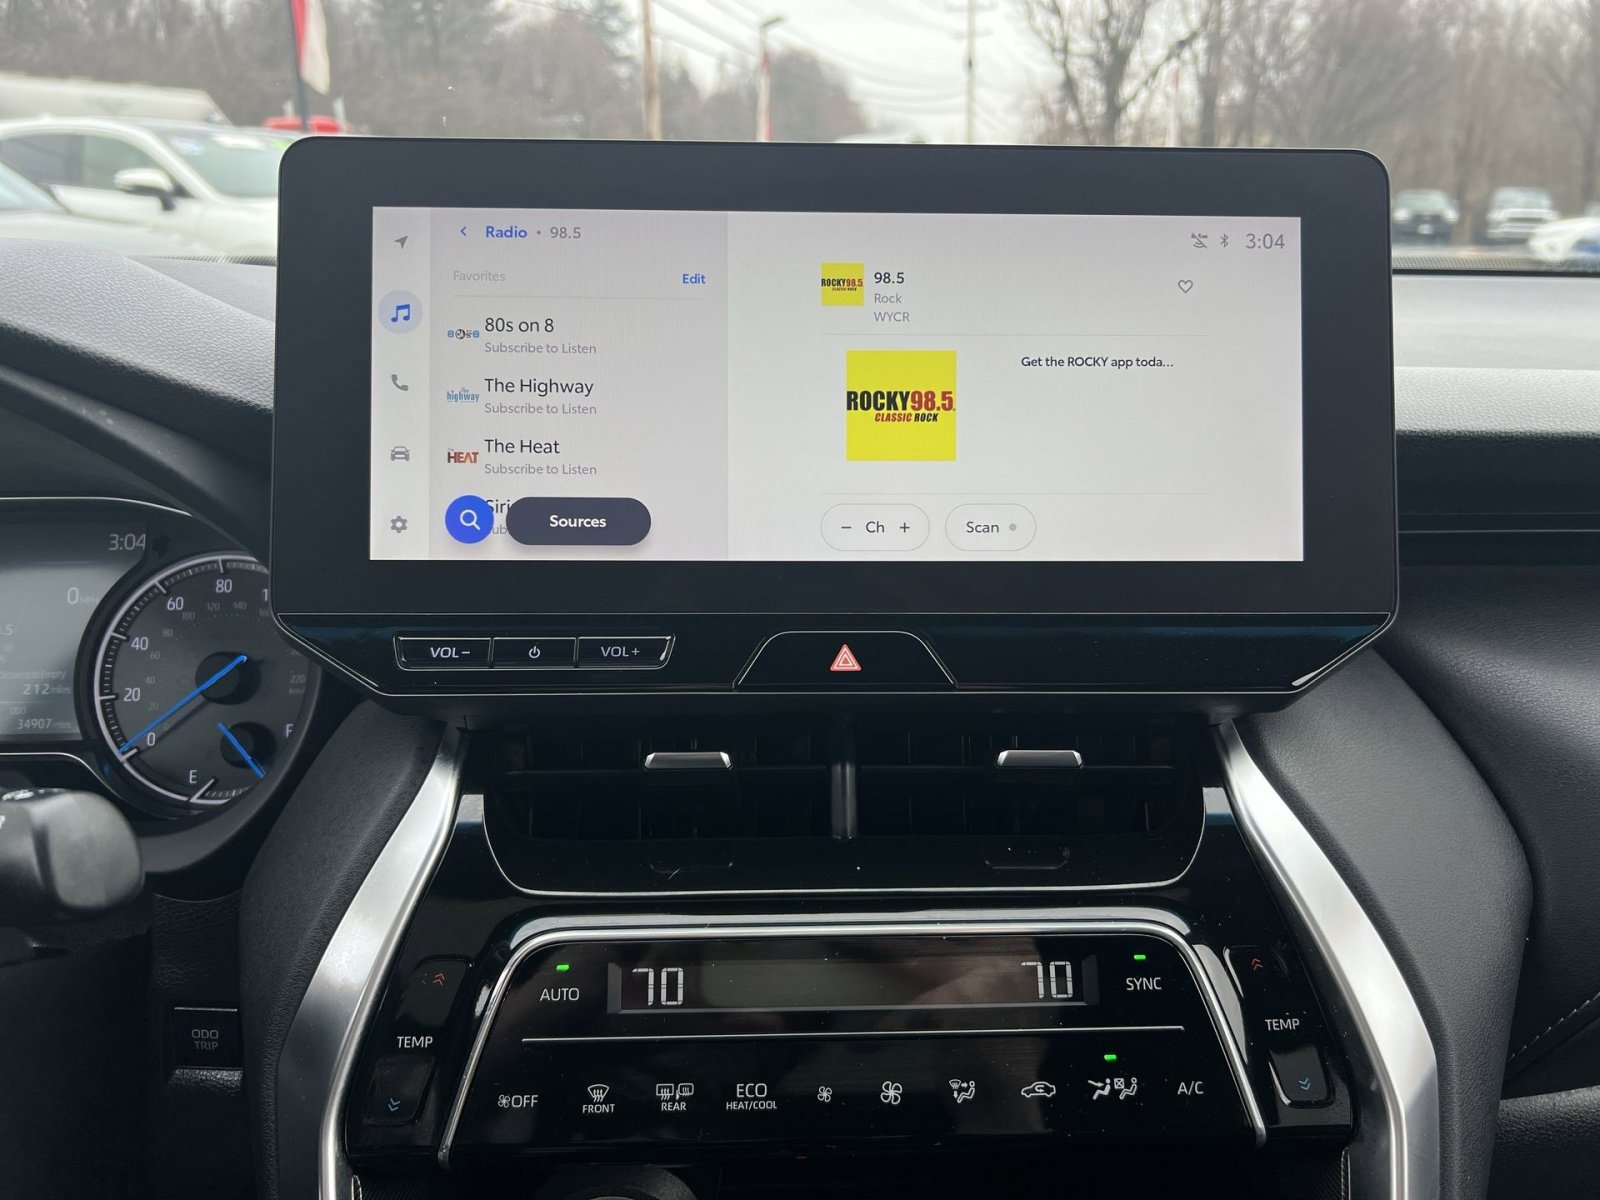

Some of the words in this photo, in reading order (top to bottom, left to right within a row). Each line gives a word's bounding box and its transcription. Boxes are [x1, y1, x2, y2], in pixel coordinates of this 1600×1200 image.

[486, 226, 528, 239] Radio
[550, 226, 582, 240] 98.5
[1245, 233, 1286, 250] 3:04
[453, 270, 506, 282] Favorites
[682, 272, 706, 285] Edit
[874, 272, 905, 284] 98.5
[874, 293, 902, 304] Rock
[874, 312, 910, 322] WYCR
[484, 318, 514, 333] 80s
[518, 321, 540, 333] on
[544, 318, 554, 334] 8
[484, 342, 544, 354] Subscribe
[546, 344, 558, 354] to
[562, 343, 597, 355] Listen
[1021, 356, 1042, 368] Get
[1045, 356, 1065, 368] the
[1067, 356, 1108, 368] ROCKY
[1111, 358, 1133, 370] app
[1136, 356, 1174, 368] toda...
[484, 378, 516, 394] The
[520, 378, 594, 398] Highway
[446, 390, 480, 402] highway
[484, 402, 544, 414] Subscribe
[546, 404, 558, 414] to
[562, 404, 598, 416] Listen
[874, 412, 912, 423] CLASSIC
[914, 412, 939, 423] ROCK
[484, 438, 516, 454] The
[520, 439, 560, 454] Heat
[448, 452, 480, 464] HEAT
[484, 463, 544, 475] Subscribe
[546, 464, 558, 475] to
[562, 464, 598, 476] Listen
[486, 499, 511, 514] Siri
[549, 515, 607, 528] Sources
[866, 520, 885, 534] Ch
[966, 521, 1000, 534] Scan
[108, 533, 147, 551] 3:04
[216, 579, 232, 593] 80
[66, 587, 80, 604] 0
[167, 596, 184, 611] 60
[132, 636, 149, 651] 40
[23, 684, 50, 696] 212
[124, 688, 141, 702] 20
[17, 718, 52, 730] 34907
[286, 724, 294, 738] F
[147, 732, 156, 747] 0
[190, 770, 198, 784] E
[631, 967, 684, 1006] 70
[1021, 960, 1074, 1000] 70
[1126, 977, 1162, 991] SYNC
[540, 987, 580, 1002] AUTO
[1265, 1018, 1300, 1031] TEMP
[192, 1028, 218, 1039] ODO
[194, 1040, 218, 1050] TRIP
[396, 1036, 434, 1049] TEMP
[736, 1083, 768, 1098] ECO
[1178, 1080, 1204, 1095] A/C
[510, 1094, 538, 1108] OFF
[660, 1102, 687, 1112] REAR
[726, 1100, 778, 1110] HEAT/COOL
[582, 1103, 616, 1114] FRONT
